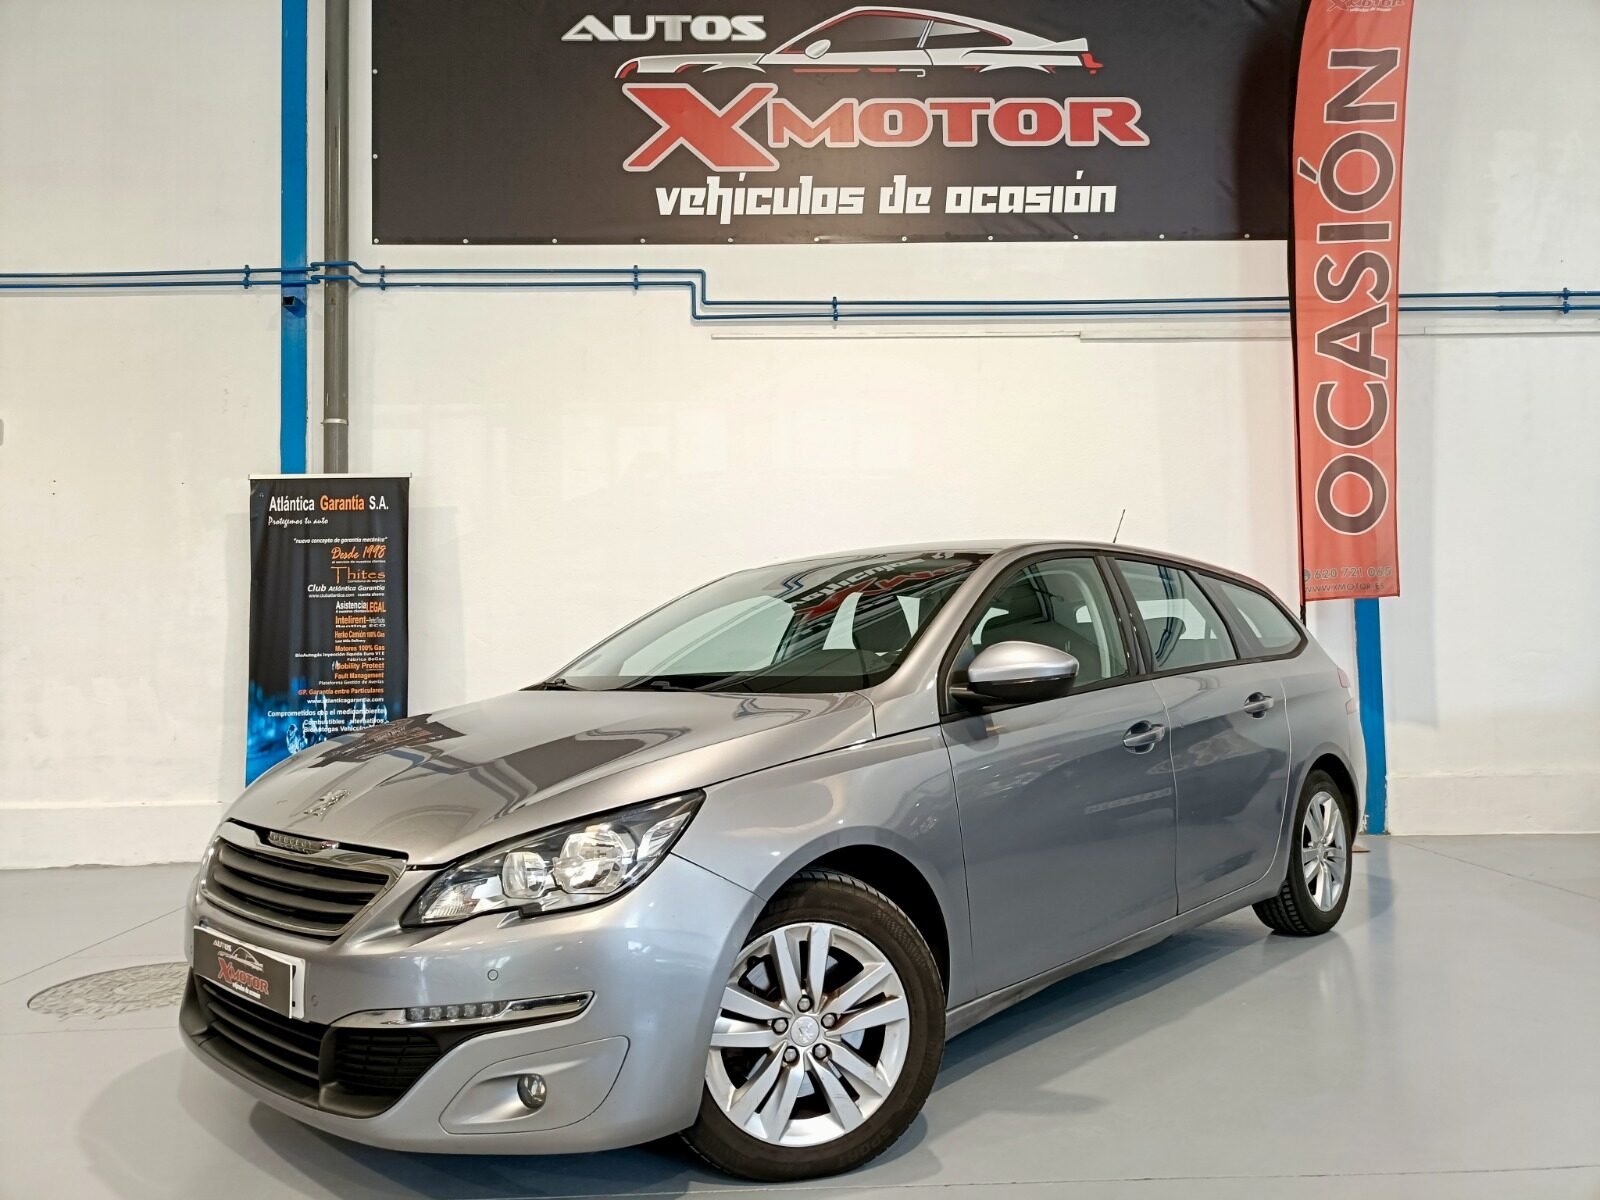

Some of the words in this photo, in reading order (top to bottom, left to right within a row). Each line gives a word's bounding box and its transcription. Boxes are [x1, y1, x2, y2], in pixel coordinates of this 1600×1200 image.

[561, 14, 767, 42] AUTOS
[655, 172, 865, 225] vehículos
[879, 174, 932, 214] de
[945, 170, 1117, 214] ocasión
[1297, 47, 1401, 536] OCASIÓN
[269, 495, 315, 512] Atlántica
[320, 494, 365, 511] Garantía
[369, 495, 389, 510] S.A.
[304, 517, 312, 525] tu
[313, 517, 329, 525] auto
[331, 546, 359, 560] Desde
[362, 545, 387, 559] 1998
[1314, 568, 1338, 579] 620
[1341, 566, 1363, 577] 721
[307, 584, 327, 592] Club
[267, 709, 316, 718] Comprometidos
